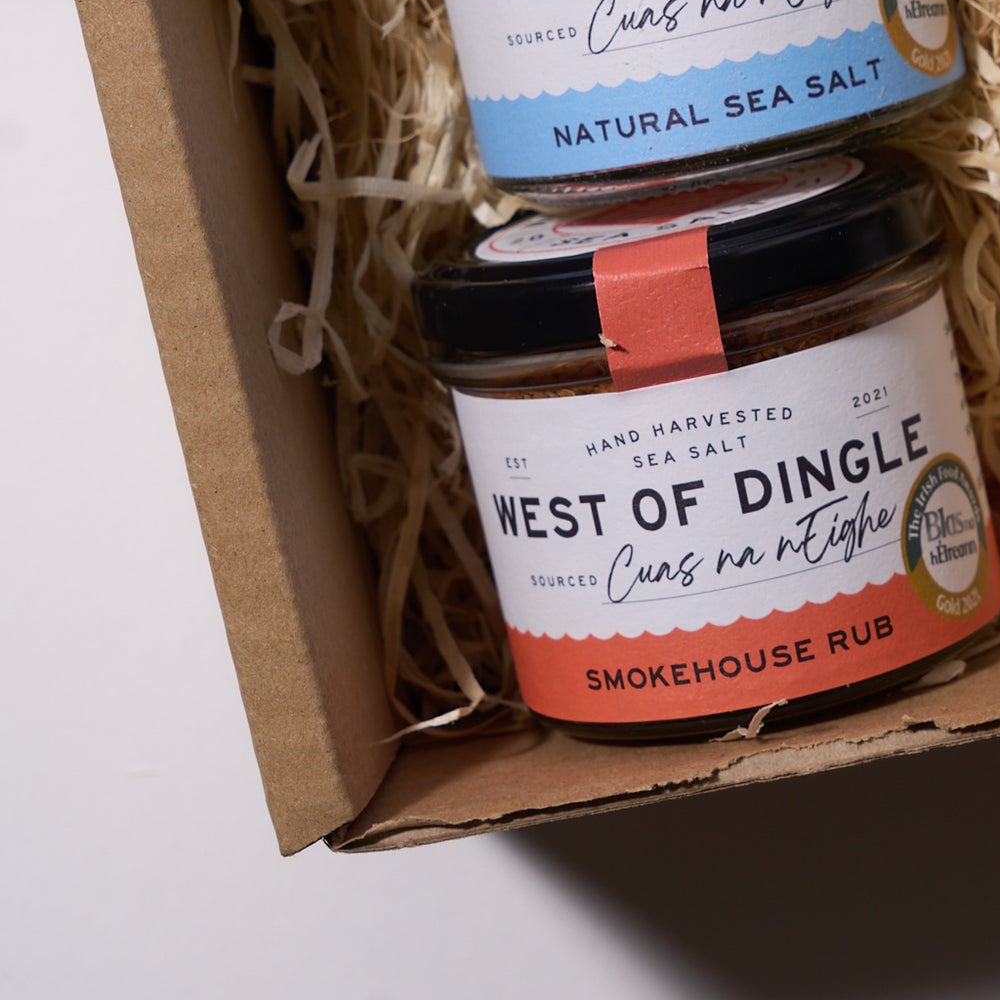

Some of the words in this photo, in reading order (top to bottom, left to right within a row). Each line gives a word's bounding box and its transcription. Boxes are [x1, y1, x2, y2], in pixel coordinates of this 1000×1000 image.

[506, 26, 578, 47] SOURCED
[553, 103, 710, 149] NATURAL
[723, 84, 795, 119] SEA
[805, 57, 884, 96] SALT
[852, 385, 889, 408] 2021
[585, 429, 640, 457] HAND
[652, 406, 794, 438] HARVESTED
[505, 456, 528, 470] EST
[632, 449, 676, 469] SEA
[688, 435, 750, 460] SALT
[492, 493, 607, 539] WEST
[631, 479, 705, 532] OF
[733, 413, 929, 514] DINGLE
[908, 507, 923, 541] The
[918, 473, 938, 506] Irish
[923, 507, 964, 542] Blas
[530, 574, 598, 588] SOURCED
[606, 543, 704, 604] Cuas
[715, 546, 766, 575] na
[935, 592, 961, 616] Gold
[585, 638, 816, 692] SMOKEHOUSE
[826, 613, 895, 655] RUB
